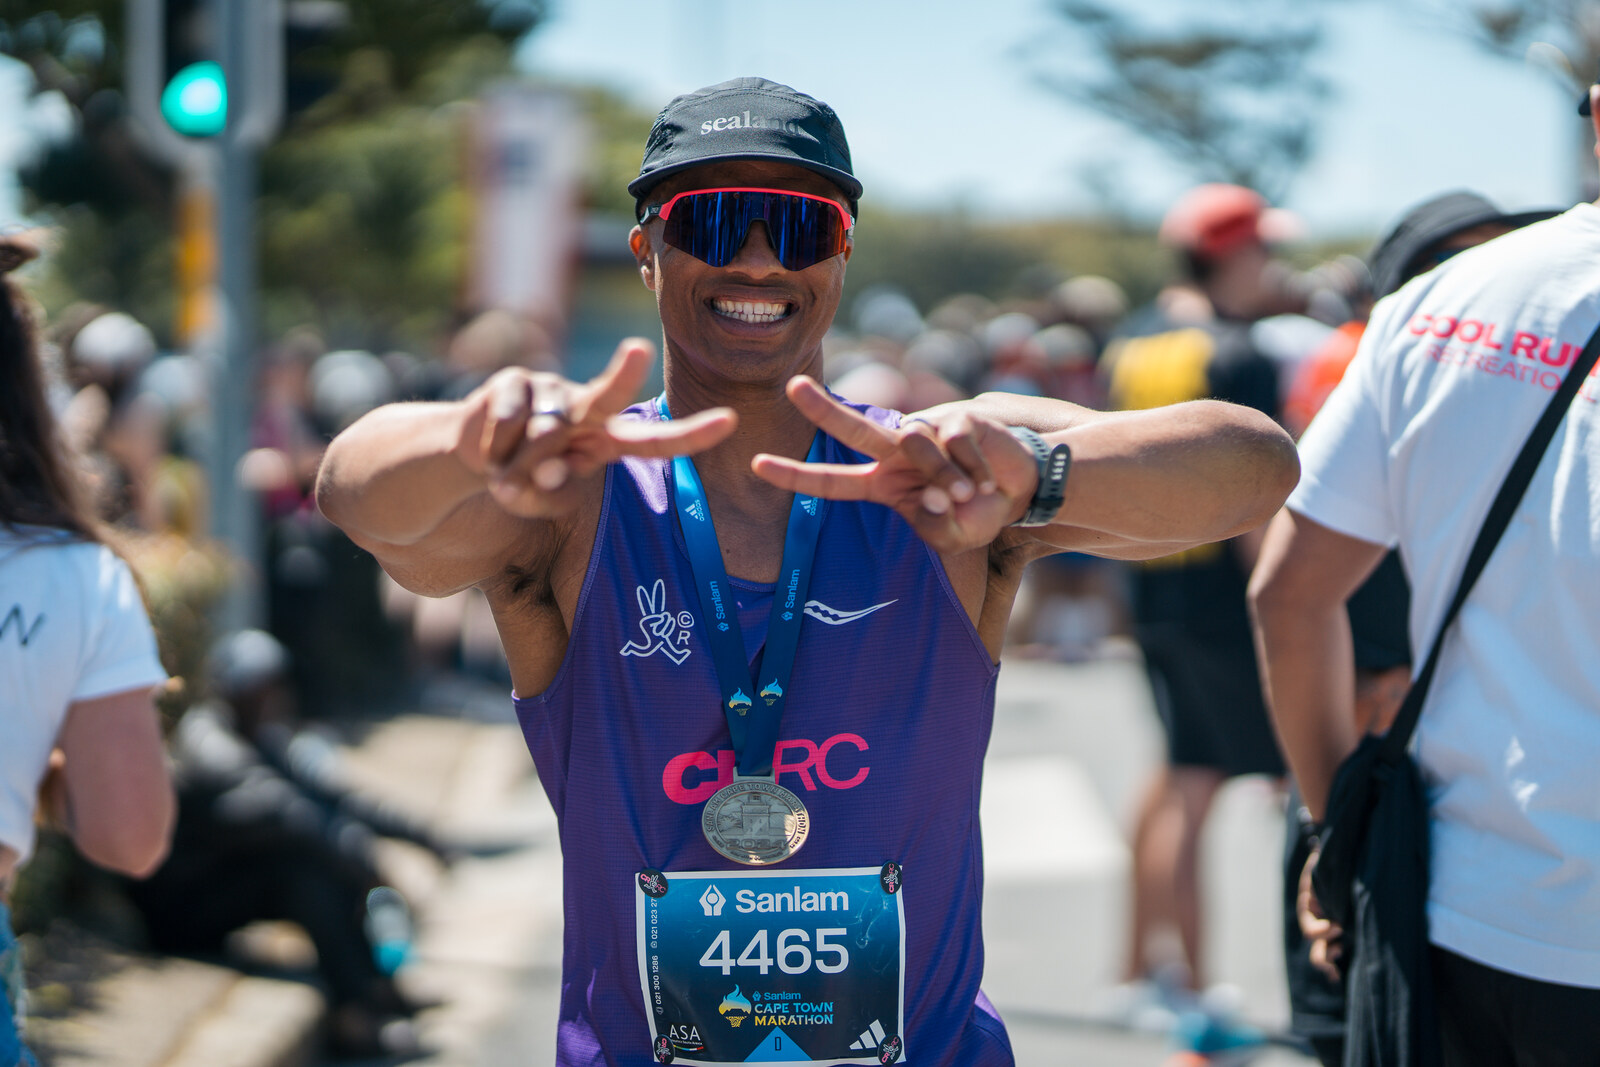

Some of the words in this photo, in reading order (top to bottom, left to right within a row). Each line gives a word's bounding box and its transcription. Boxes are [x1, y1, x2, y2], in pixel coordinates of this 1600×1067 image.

[701, 110, 800, 135] sealand
[1409, 314, 1503, 351] COOL
[709, 581, 726, 620] Sanlam
[785, 568, 801, 609] Sanlam
[720, 784, 746, 800] CAPE
[747, 783, 778, 794] TOWN
[735, 886, 849, 914] Sanlam
[699, 928, 850, 976] 4465
[754, 1003, 789, 1014] CAPE
[793, 1001, 834, 1013] TOWN
[764, 990, 801, 1001] Sanlam
[669, 1024, 701, 1041] ASA
[754, 1013, 834, 1027] MARATHON
